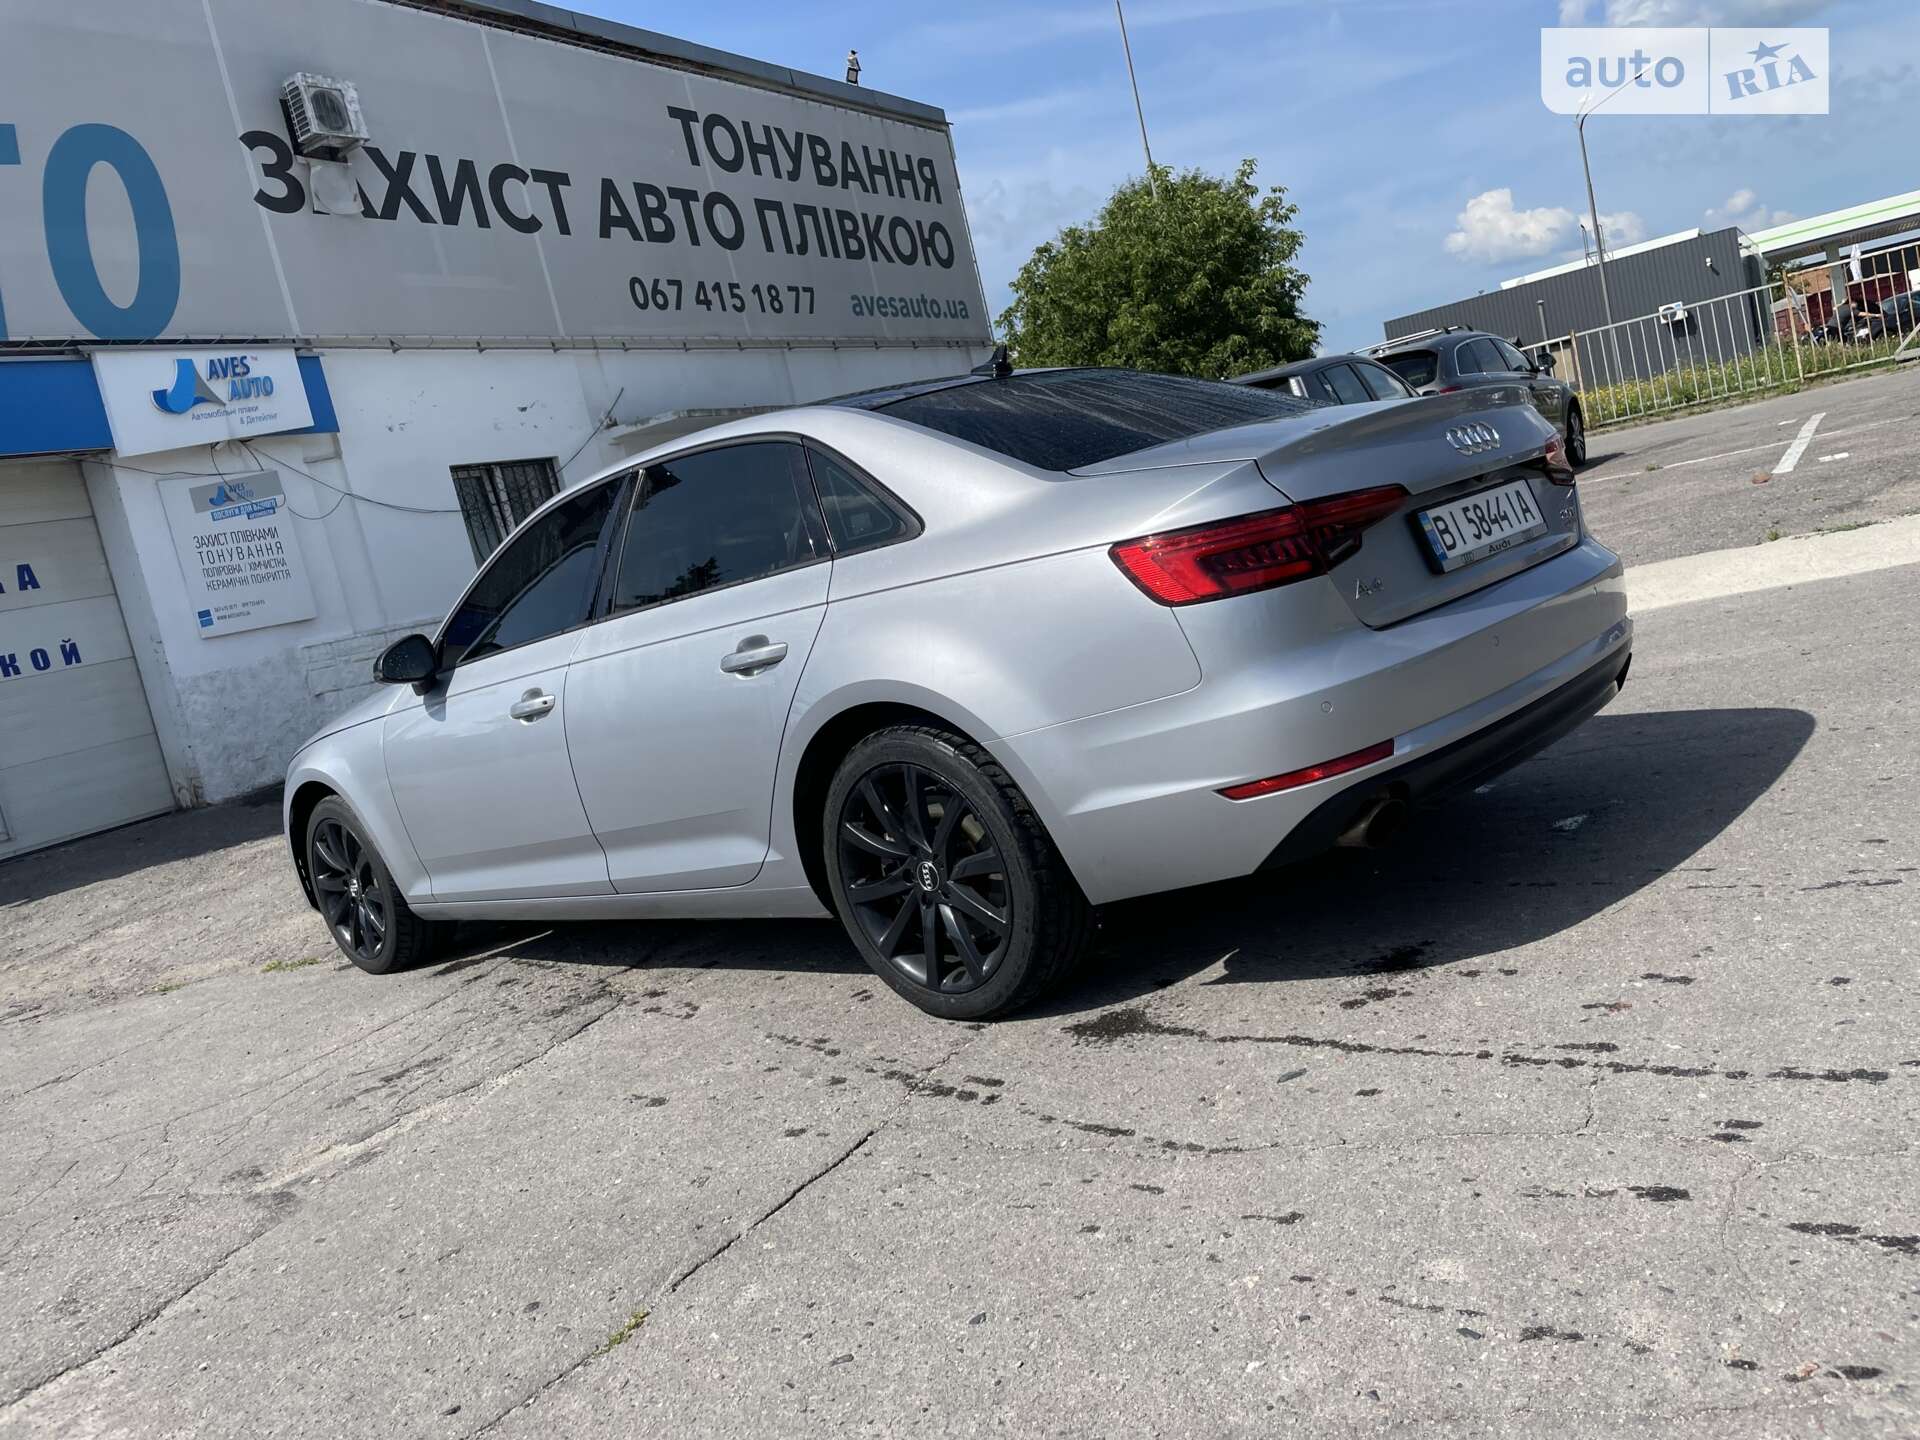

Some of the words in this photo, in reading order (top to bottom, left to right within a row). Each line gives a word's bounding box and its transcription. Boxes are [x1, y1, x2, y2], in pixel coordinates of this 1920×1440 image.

[666, 105, 943, 205] ТОНУВАННЯ
[599, 177, 745, 251] АВТО
[753, 198, 955, 269] ПЛІВКОЮ
[628, 276, 683, 311] 067
[694, 281, 746, 314] 415
[751, 284, 784, 314] 18
[787, 285, 815, 314] 77
[851, 292, 970, 320] avesauto.ua
[207, 356, 251, 380] AVES
[228, 375, 274, 401] AUTO
[1431, 511, 1467, 551] BI
[1461, 496, 1513, 541] 5844
[1505, 489, 1536, 526] IA
[193, 532, 229, 549] ЗАХИСТ
[230, 526, 279, 545] ПЛІВКАМИ
[1487, 539, 1511, 554] Audi
[197, 541, 284, 566] ТОНУВАННЯ
[206, 575, 249, 591] КЕРАМІЧНІ
[251, 569, 292, 584] ПОКРИТТЯ
[1355, 577, 1385, 600] A4
[0, 638, 82, 678] КОЙ
